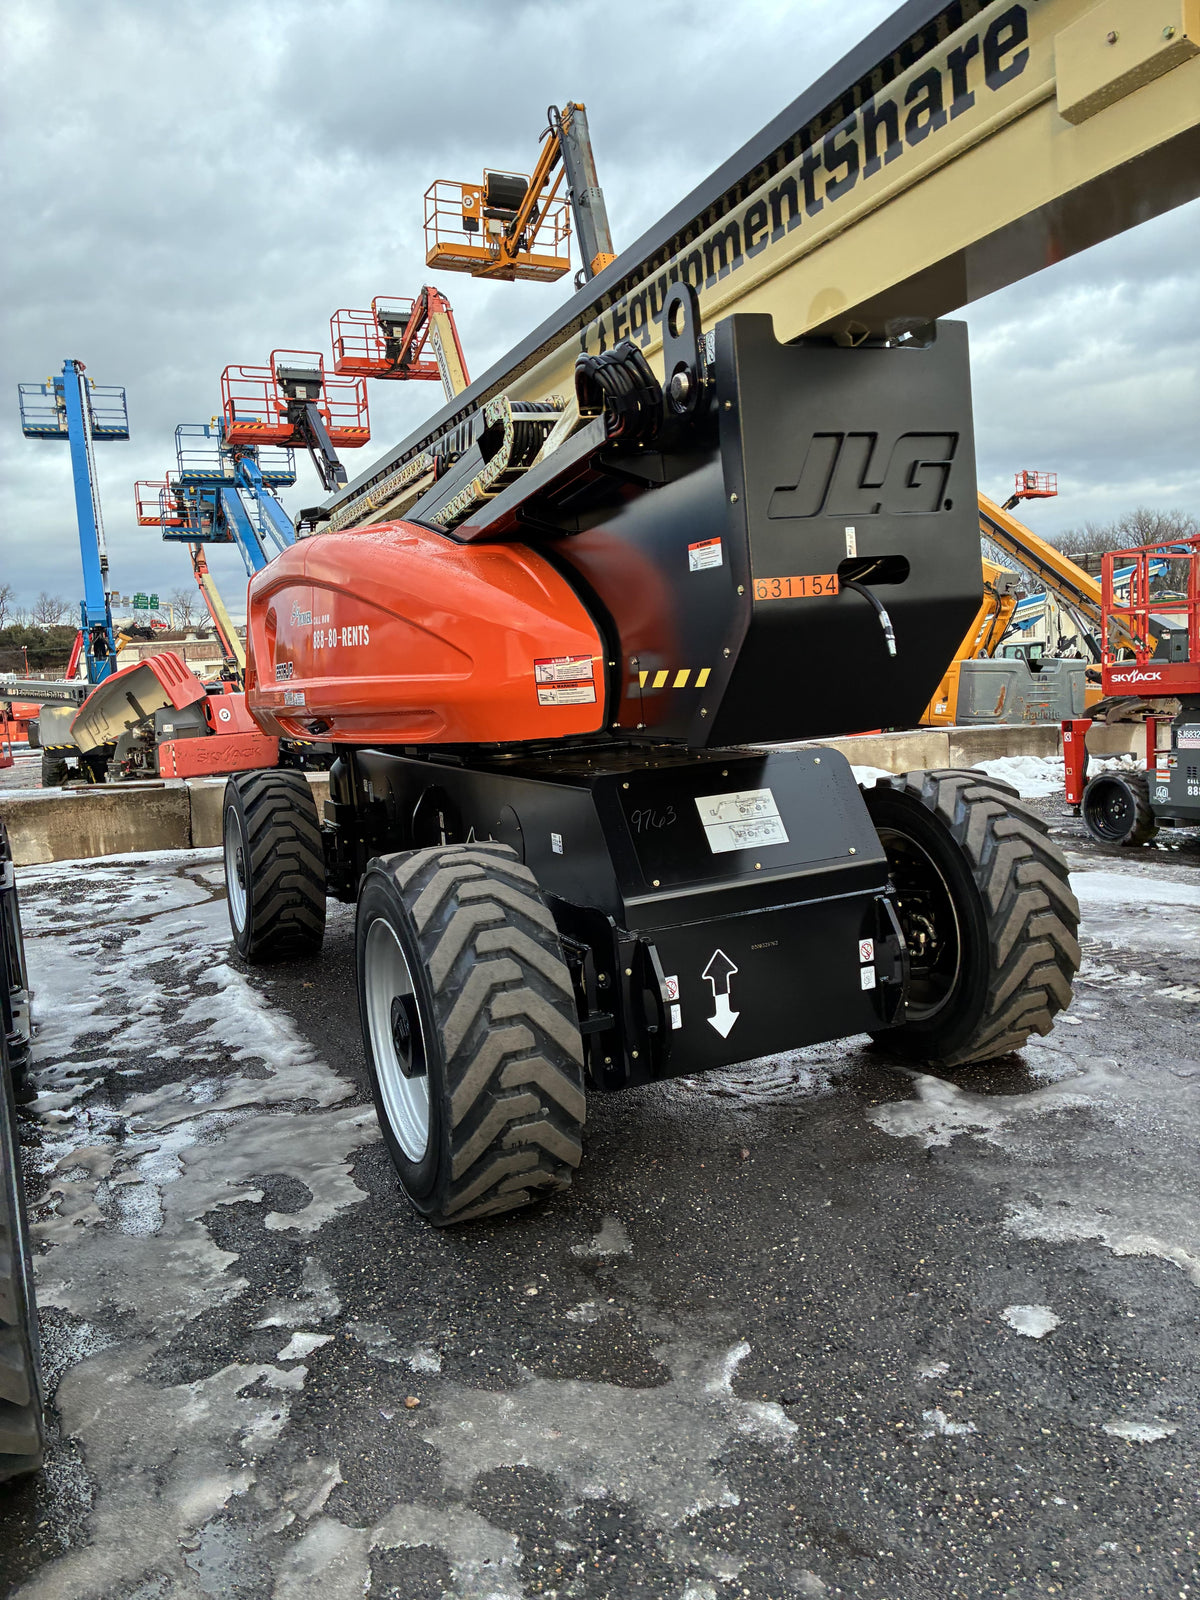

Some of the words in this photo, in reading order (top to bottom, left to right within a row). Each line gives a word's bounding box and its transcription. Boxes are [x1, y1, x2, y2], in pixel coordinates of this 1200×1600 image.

[611, 3, 1030, 350] EquipmentShare
[766, 431, 960, 520] JLG
[756, 575, 837, 600] 631154
[313, 625, 370, 649] 888-80-RENTS
[1110, 669, 1162, 683] SKYJACK
[1187, 785, 1200, 796] 88
